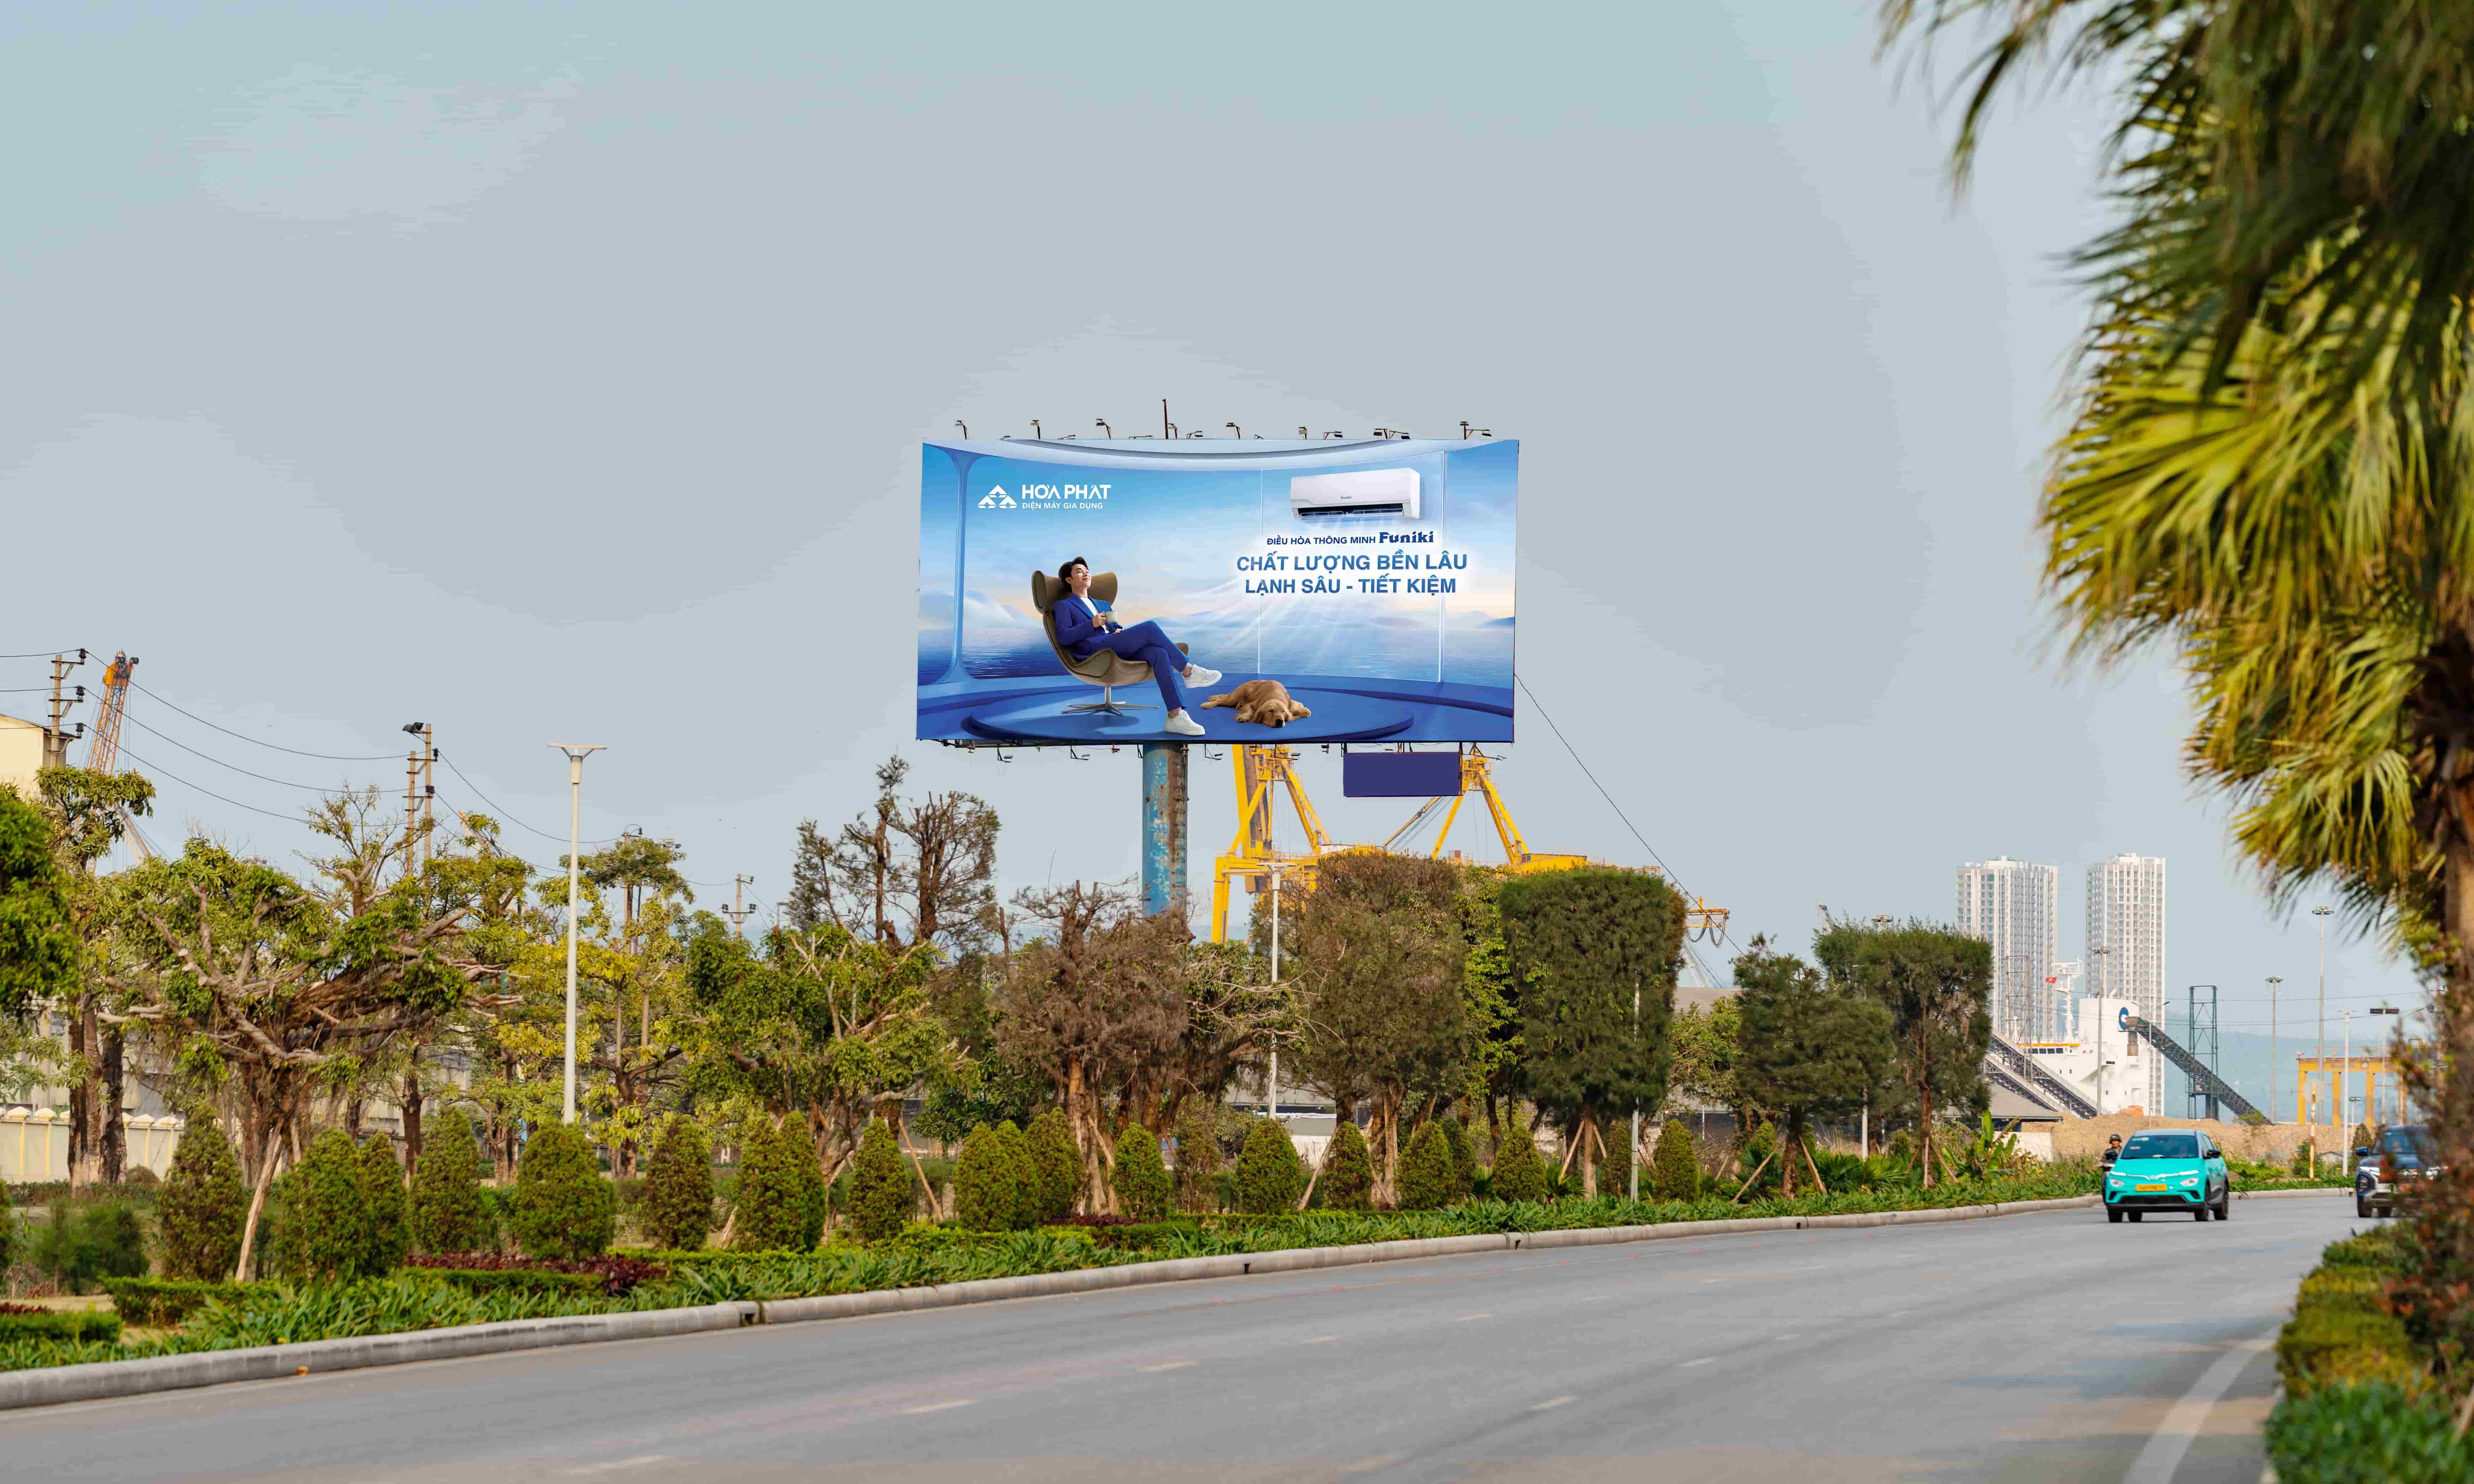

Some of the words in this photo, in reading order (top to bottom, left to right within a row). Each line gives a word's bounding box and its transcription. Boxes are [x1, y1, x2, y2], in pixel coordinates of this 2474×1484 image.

[1022, 484, 1061, 499] HÒA
[1064, 484, 1112, 499] PHÁT
[1022, 501, 1041, 510] ĐIỆN
[1079, 502, 1103, 510] DỤNG
[1267, 535, 1287, 545] ĐIỀU
[1291, 536, 1311, 544] HÒA
[1314, 536, 1347, 544] THÔNG
[1379, 531, 1434, 543] Funiki
[1237, 551, 1289, 571] CHẤT
[1295, 555, 1370, 574] LƯỢNG
[1377, 549, 1418, 570] BỀN
[1426, 550, 1467, 570] LÂU
[1245, 579, 1295, 596] LẠNH
[1302, 576, 1340, 593] SÂU
[1358, 573, 1401, 593] TIẾT
[1407, 575, 1456, 596] KIỆM
